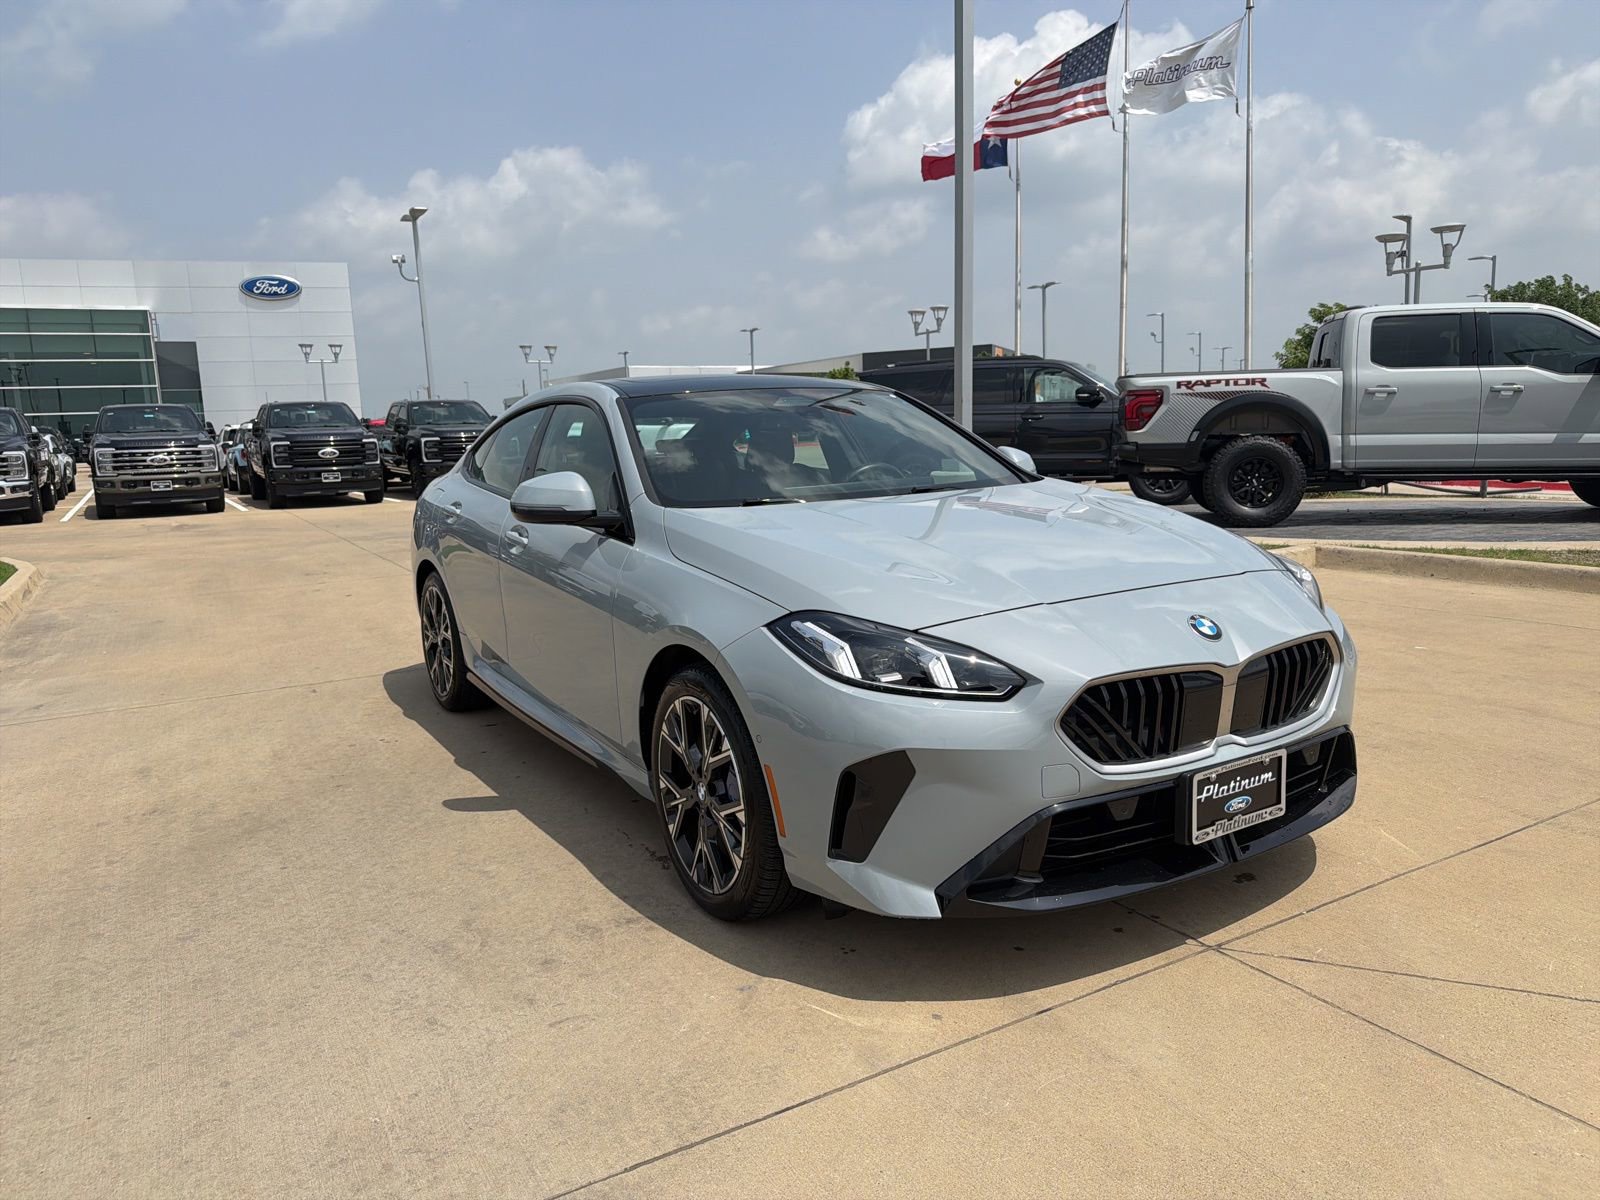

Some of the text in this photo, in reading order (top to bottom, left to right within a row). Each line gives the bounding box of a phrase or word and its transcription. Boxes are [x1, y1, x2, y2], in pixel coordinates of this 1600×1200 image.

[1125, 55, 1231, 86] Platinum
[253, 280, 288, 294] Ford
[1176, 378, 1270, 391] RAPTOR
[1197, 771, 1276, 803] Platinum
[1229, 799, 1247, 811] Ford
[1214, 812, 1267, 836] Platinum
